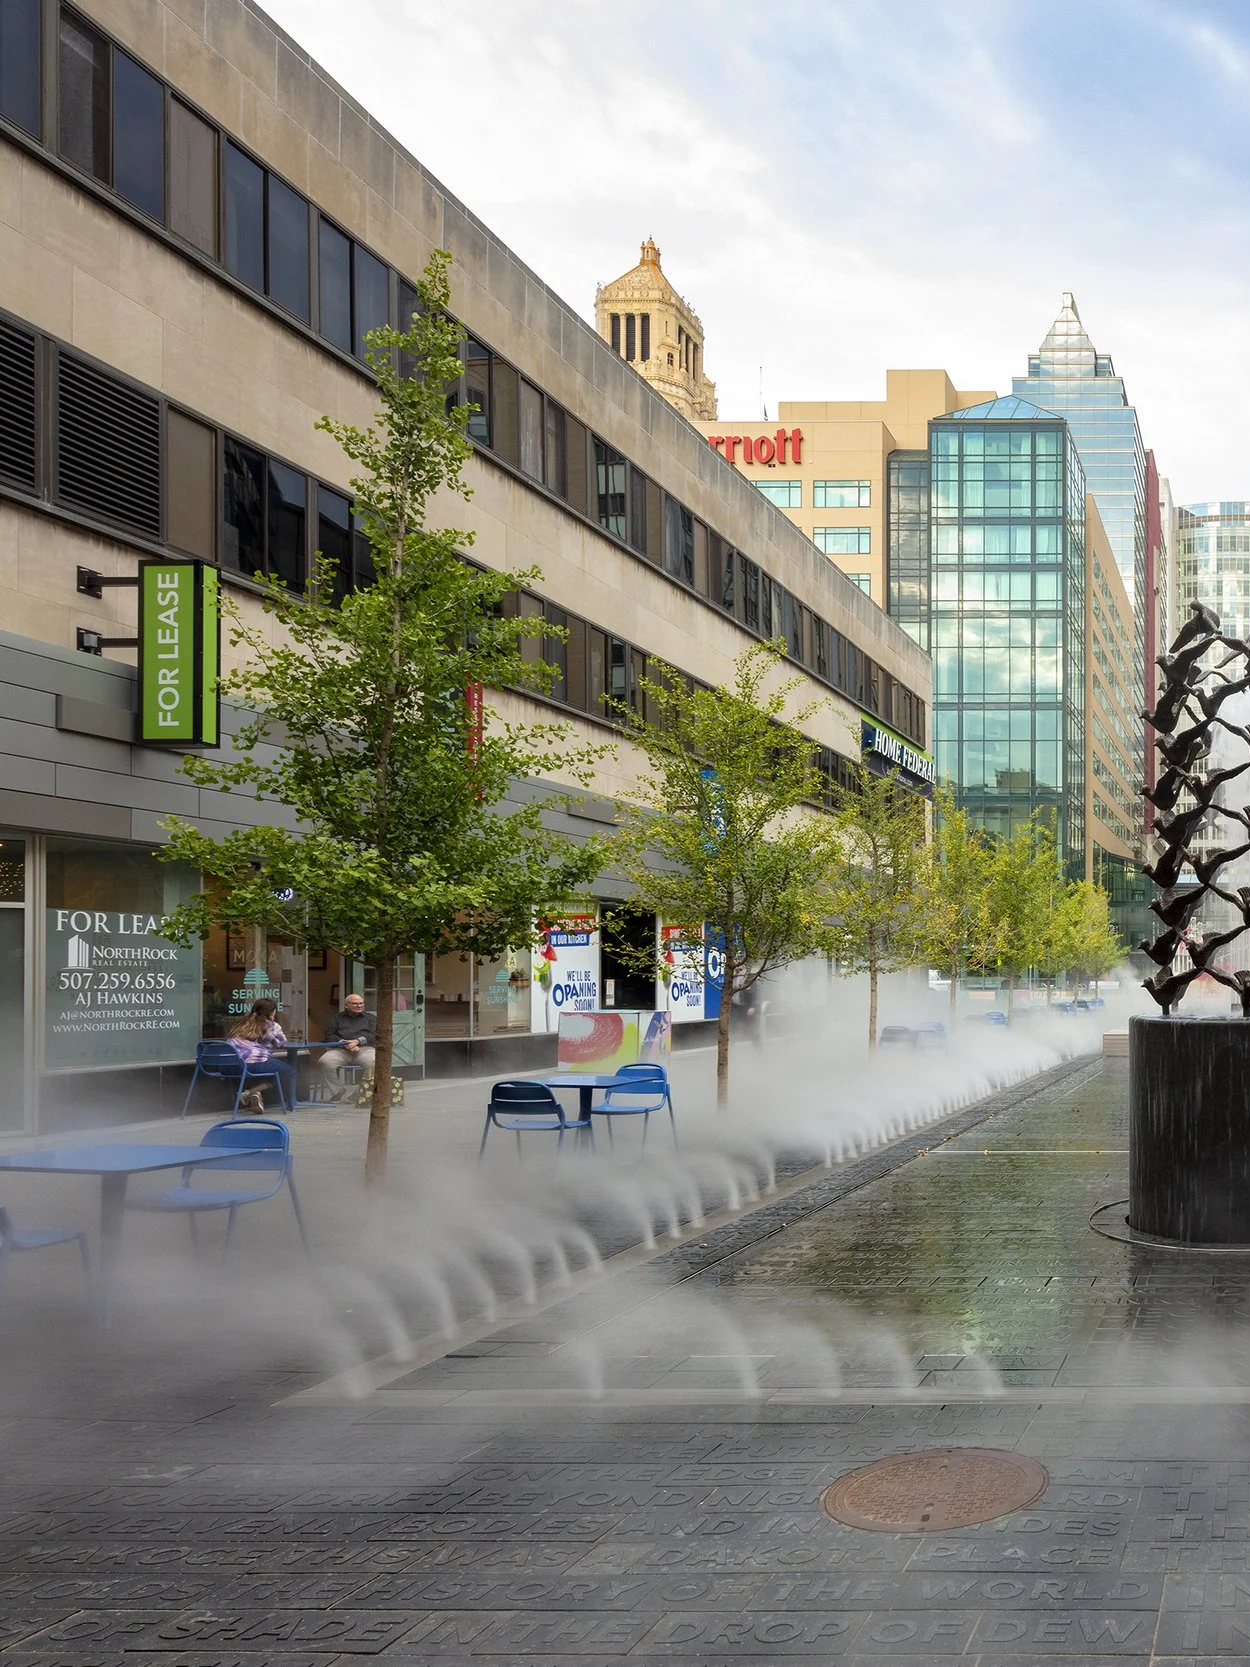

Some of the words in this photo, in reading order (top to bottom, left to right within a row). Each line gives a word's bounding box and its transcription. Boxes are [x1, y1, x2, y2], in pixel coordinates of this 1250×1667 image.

[157, 572, 179, 659] LEASE
[158, 668, 179, 726] FOR
[875, 728, 902, 763] HOME
[903, 745, 937, 785] FEDERAL
[56, 910, 112, 933] FOR
[118, 914, 183, 936] LEA
[59, 972, 176, 990] 507.259.6556
[567, 970, 582, 981] WE'LL
[584, 970, 591, 981] BE
[74, 993, 92, 1008] AJ
[232, 988, 280, 999] SERVING
[228, 1002, 283, 1014] SUNE
[465, 1468, 553, 1481] ON
[549, 1467, 665, 1481] THE
[676, 1467, 816, 1480] EDGE
[81, 1491, 293, 1506] VOICES
[289, 1491, 464, 1507] DRIFT
[462, 1491, 699, 1507] BEYOND
[65, 1517, 387, 1534] HEAVENLY
[384, 1518, 612, 1535] BODIES
[613, 1518, 750, 1535] AND
[270, 1546, 424, 1565] THIS
[428, 1547, 584, 1567] WAS
[642, 1547, 907, 1566] DAKOTA
[918, 1546, 1114, 1565] PLACE
[213, 1579, 359, 1601] THE
[351, 1579, 648, 1602] HISTORY
[654, 1581, 757, 1602] OF
[763, 1580, 892, 1602] THE
[914, 1579, 1150, 1602] WORLD
[37, 1619, 159, 1643] OF
[144, 1617, 408, 1644] SHADE
[406, 1619, 500, 1644] IN
[496, 1619, 645, 1644] THE
[653, 1619, 854, 1644] DROP
[865, 1619, 968, 1644] OF
[980, 1618, 1142, 1644] DEW
